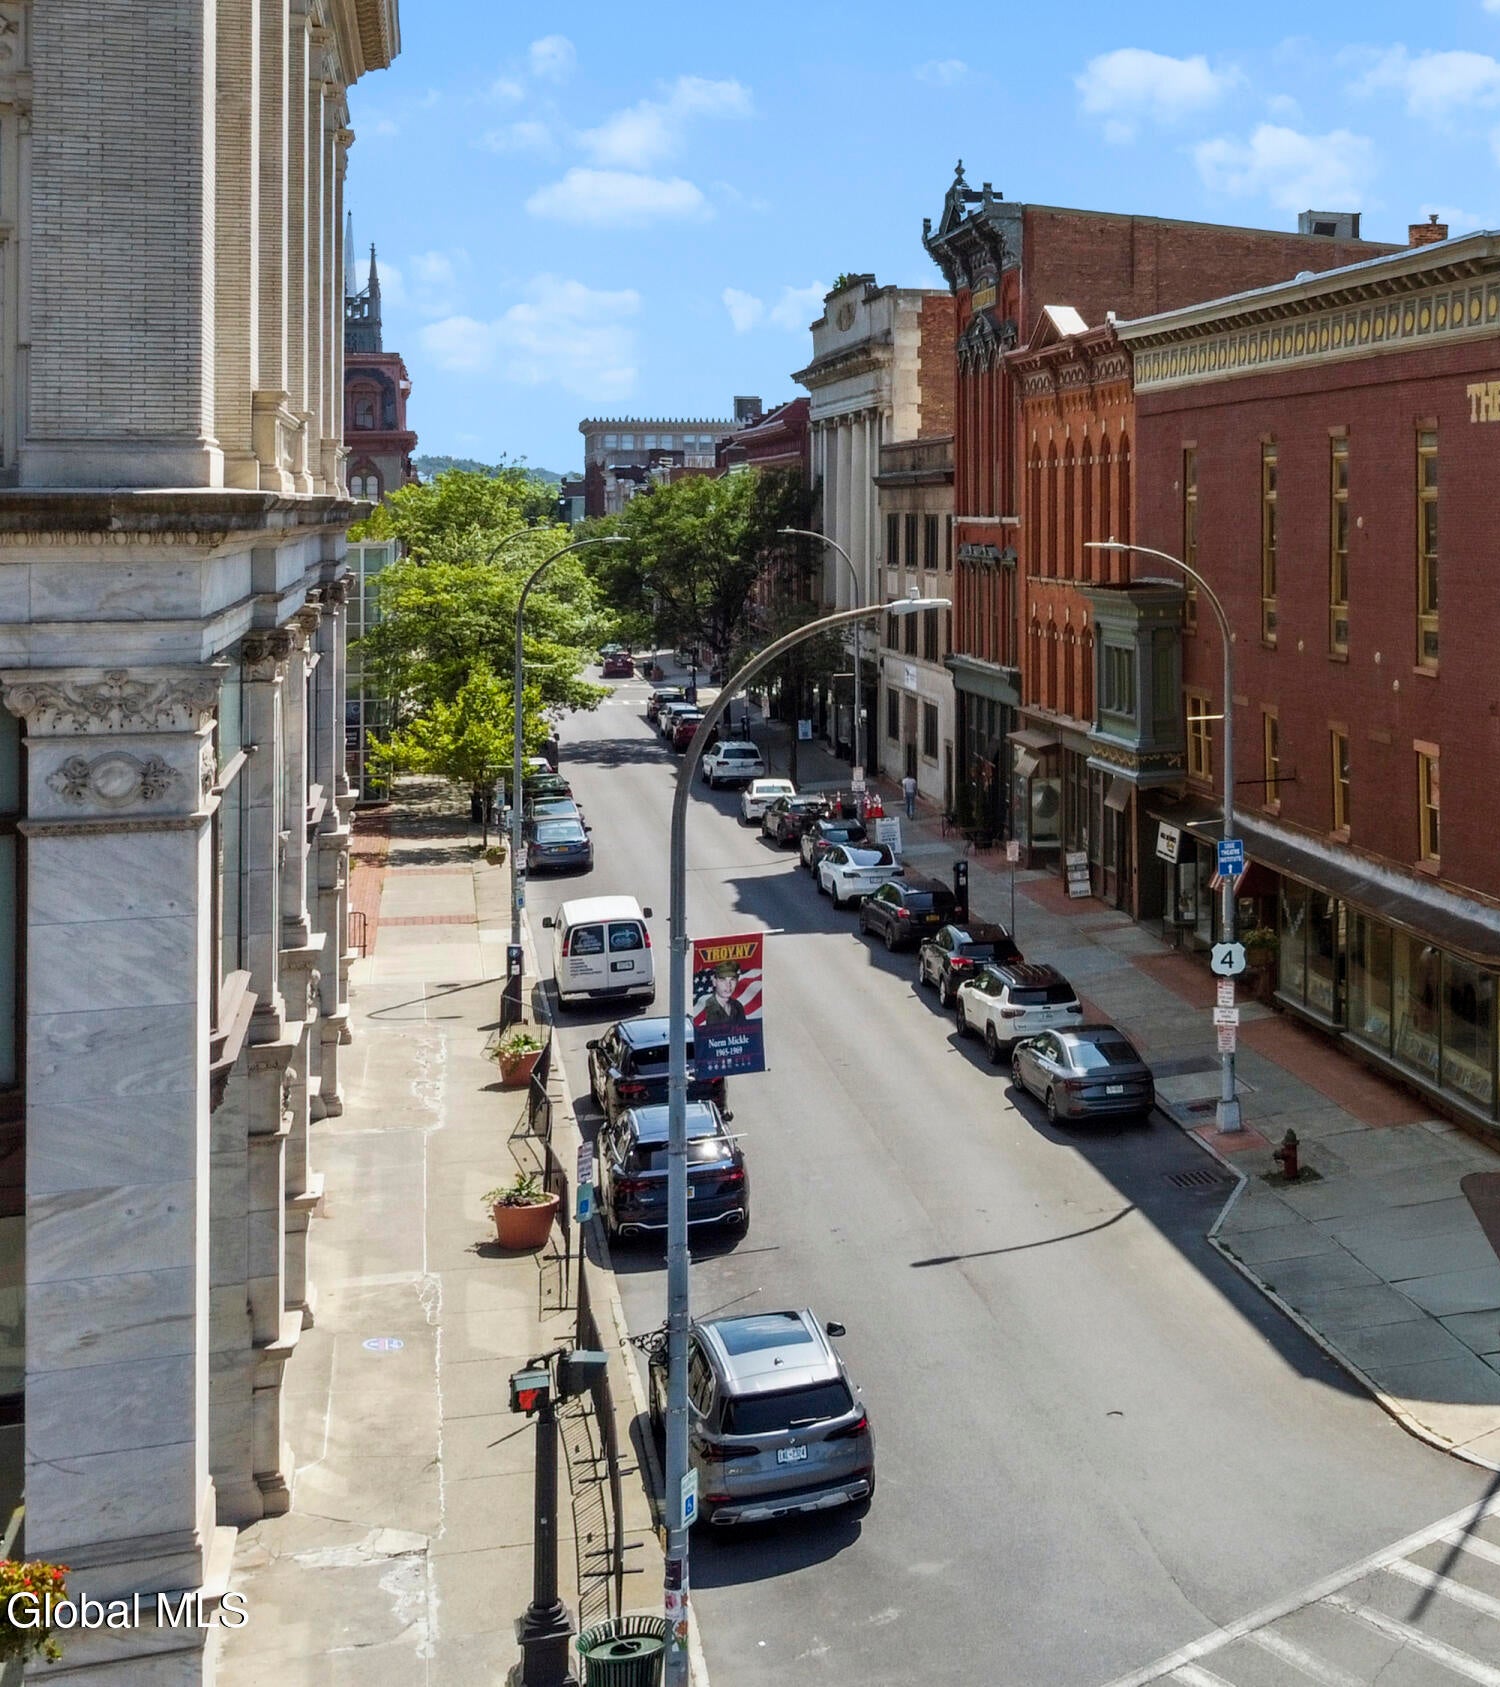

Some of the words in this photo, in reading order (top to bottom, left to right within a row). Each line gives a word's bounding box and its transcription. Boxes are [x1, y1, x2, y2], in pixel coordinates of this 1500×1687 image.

[1220, 949, 1234, 969] 4
[708, 1038, 727, 1049] Norm
[727, 1034, 750, 1046] Mickle
